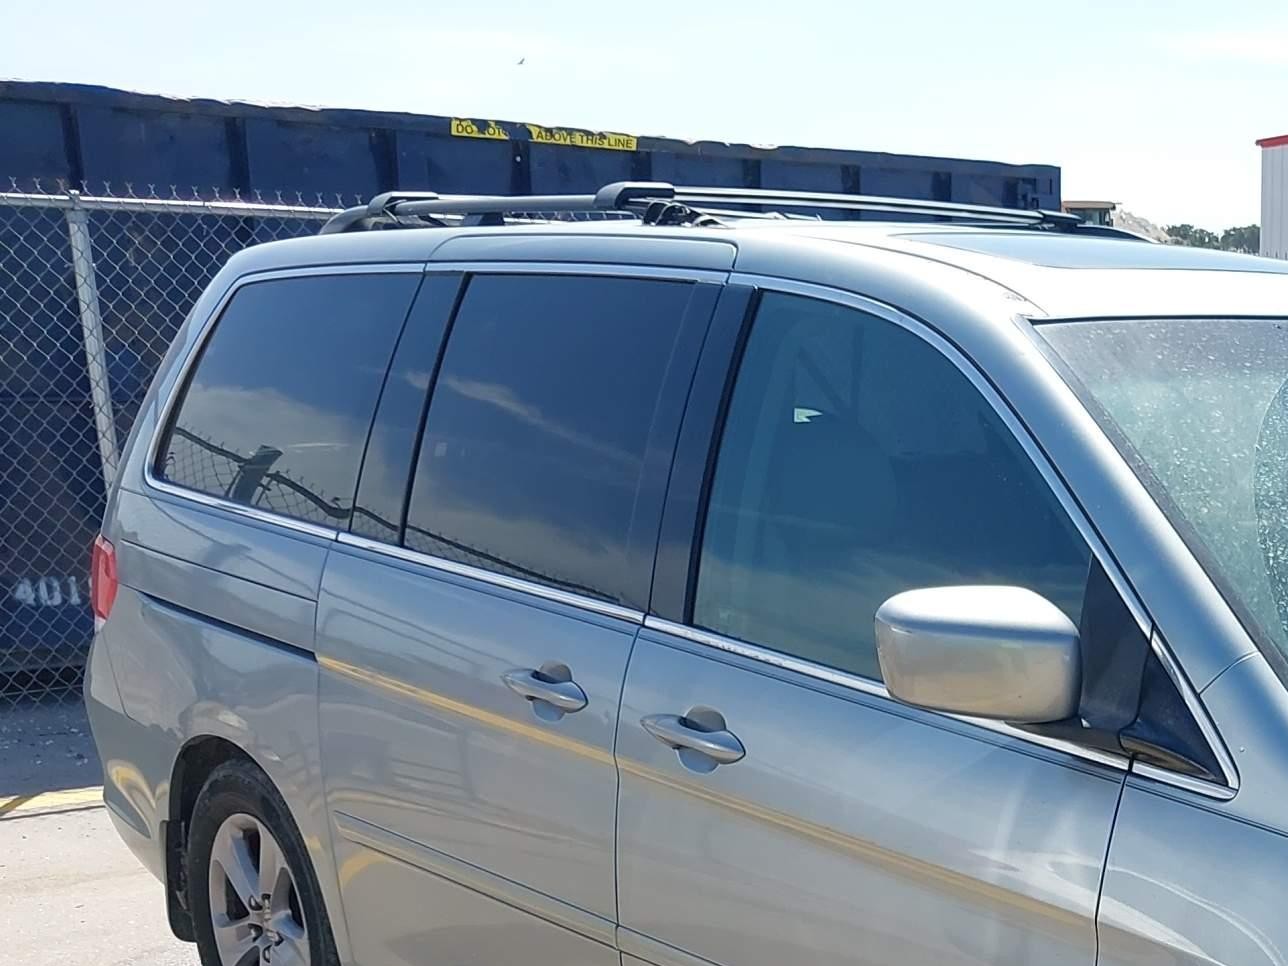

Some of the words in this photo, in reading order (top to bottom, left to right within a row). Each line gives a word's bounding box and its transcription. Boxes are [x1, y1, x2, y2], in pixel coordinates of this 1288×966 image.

[456, 123, 474, 135] DO
[535, 129, 576, 144] ABOVE
[578, 134, 605, 146] THIS
[607, 136, 633, 149] LINE
[14, 575, 93, 607] 401
